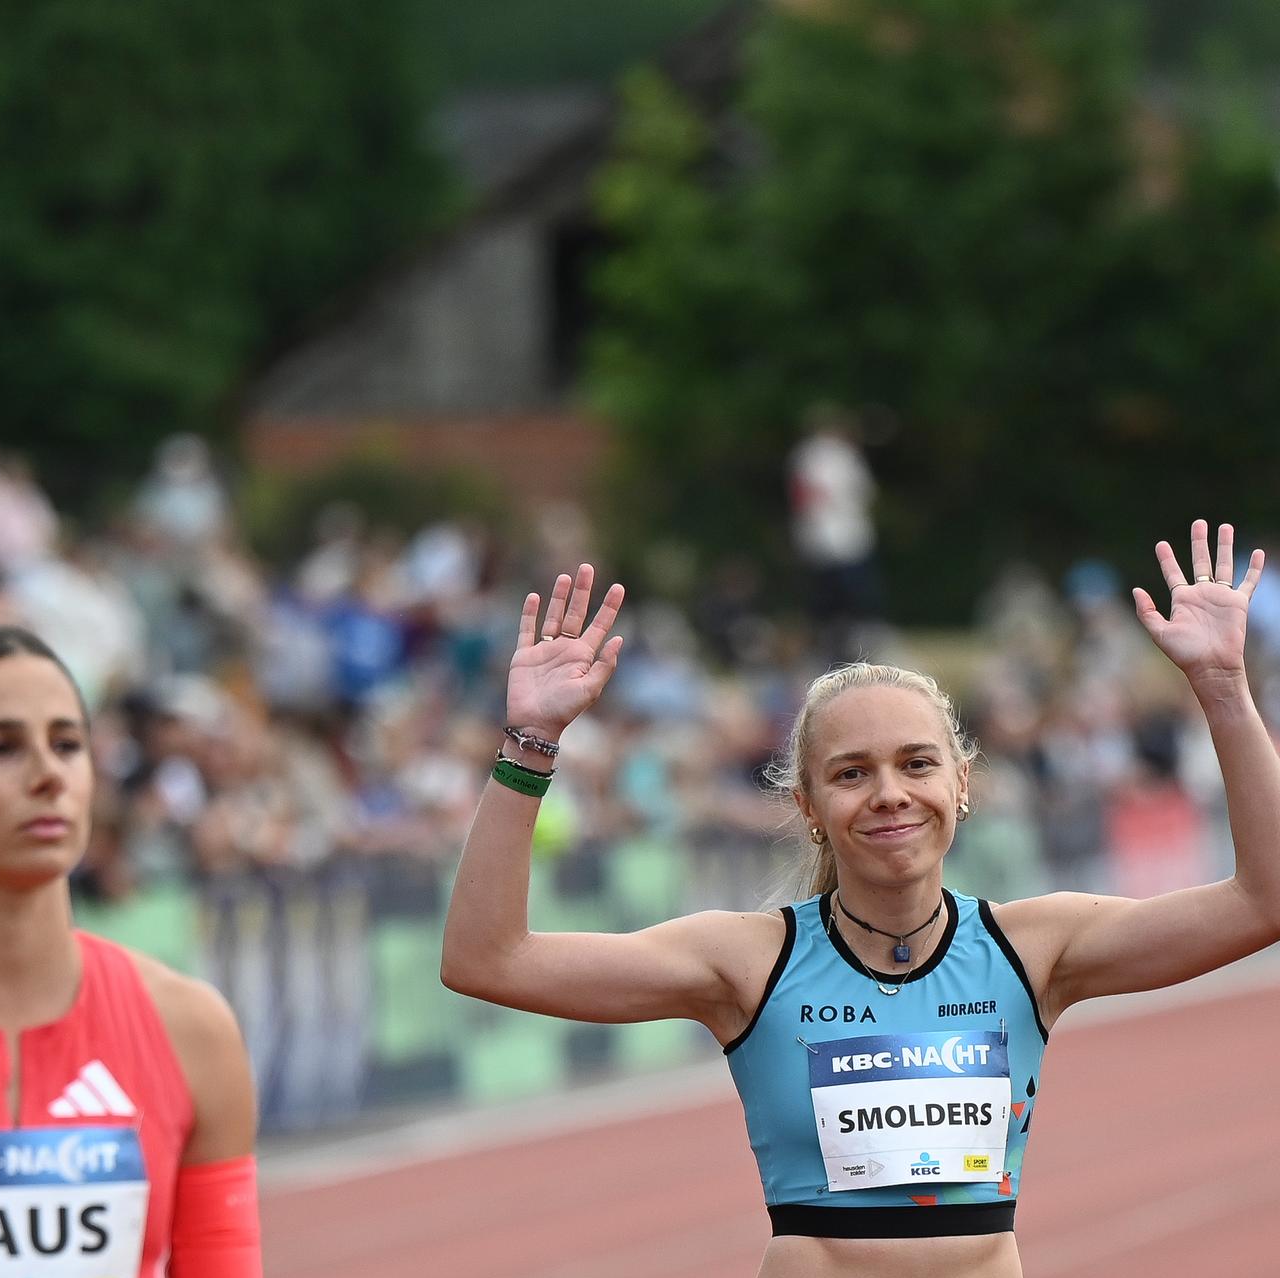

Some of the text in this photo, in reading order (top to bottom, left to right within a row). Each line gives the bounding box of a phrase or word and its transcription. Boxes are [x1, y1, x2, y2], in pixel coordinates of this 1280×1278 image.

[800, 1004, 877, 1024] ROBA
[937, 1000, 997, 1018] BIORACER
[838, 1102, 993, 1134] SMOLDERS
[910, 1166, 941, 1177] KBC
